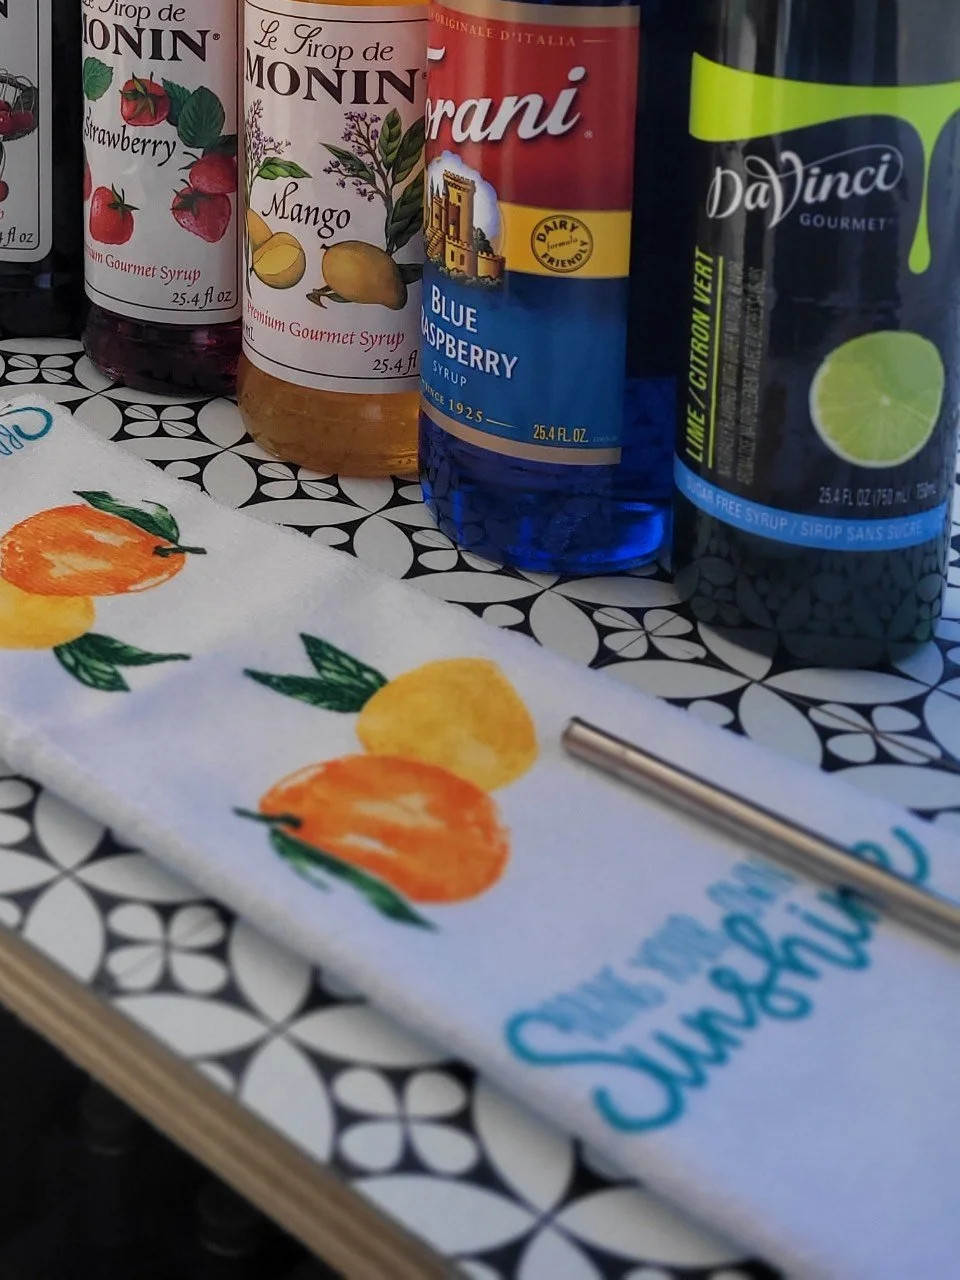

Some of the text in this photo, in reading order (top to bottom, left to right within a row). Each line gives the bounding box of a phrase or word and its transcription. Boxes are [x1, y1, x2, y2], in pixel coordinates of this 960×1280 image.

[158, 3, 186, 22] de
[253, 19, 394, 68] Le Sirop de
[499, 30, 576, 47] D'ITALIA
[83, 107, 177, 167] Strawberry
[705, 143, 904, 230] DaVinci
[261, 181, 351, 240] Mango
[799, 212, 888, 232] GOURMET
[3, 226, 17, 247] fl
[19, 232, 34, 244] oz
[536, 219, 580, 244] DAIRY
[540, 239, 589, 268] FRIENDLY
[105, 253, 157, 279] Gourmet
[160, 265, 201, 288] Syrup
[693, 244, 715, 306] VERT
[171, 286, 232, 310] 25.4 fl oz
[431, 284, 479, 334] BLUE
[246, 300, 405, 353] Premium Gourmet Syrup
[371, 349, 418, 376] 25.4 fl
[688, 307, 712, 391] CITRON
[432, 359, 468, 388] SYRUP
[449, 398, 484, 424] 1925
[533, 423, 556, 442] 25.4
[557, 427, 572, 443] FL.
[573, 427, 589, 444] OZ.
[685, 403, 707, 464] LIME
[685, 476, 716, 508] SUGAR
[716, 494, 743, 519] FREE
[745, 506, 789, 531] SYRUP
[800, 520, 843, 539] SIROP
[846, 524, 885, 543] SANS
